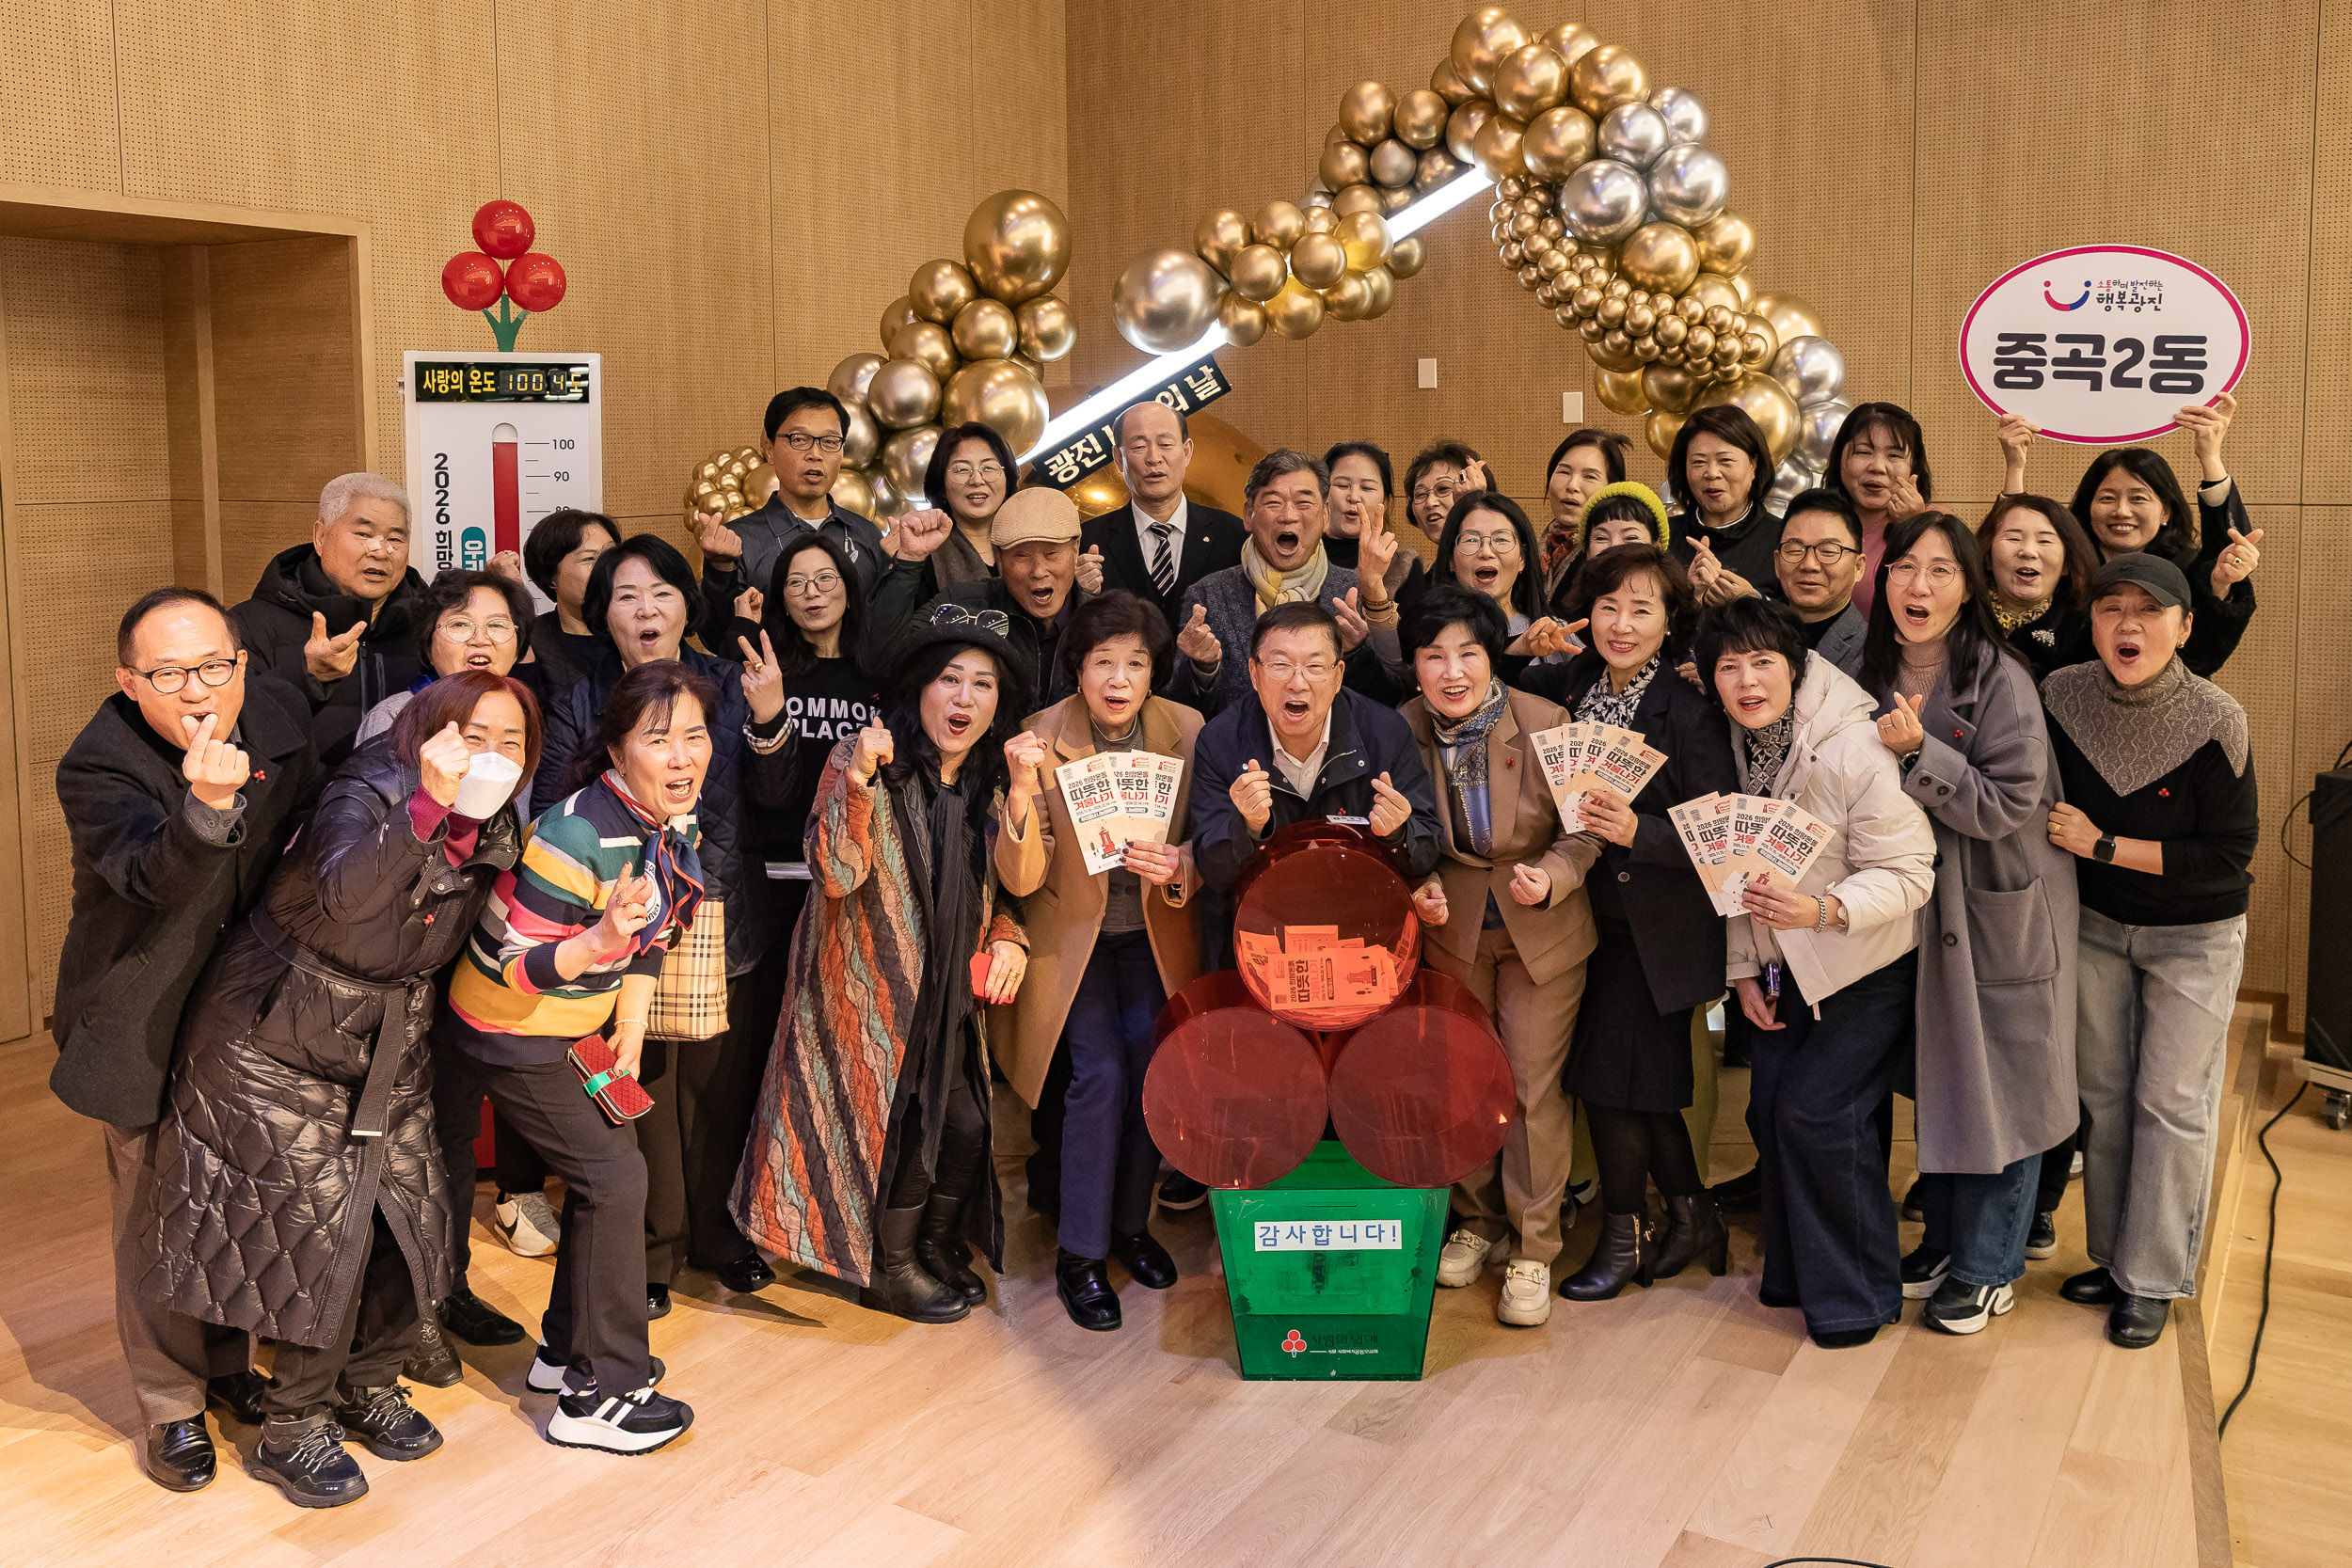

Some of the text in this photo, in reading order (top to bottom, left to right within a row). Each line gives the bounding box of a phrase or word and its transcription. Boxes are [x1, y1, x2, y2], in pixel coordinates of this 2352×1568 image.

[2097, 279, 2163, 293] 소통하며 발전하는
[2096, 291, 2163, 312] 행복광진
[1993, 333, 2208, 394] 중곡2동
[423, 370, 464, 393] 사랑의
[469, 370, 496, 393] 온도
[1044, 365, 1221, 483] 광진 날
[552, 439, 575, 450] 100
[554, 471, 570, 482] 90
[434, 452, 451, 525] 2026
[1613, 747, 1629, 757] 2026
[1600, 760, 1641, 784] 겨울나기
[1606, 751, 1647, 779] 따뜻한
[1067, 780, 1084, 789] 2026
[1069, 779, 1111, 801] 따뜻한
[1073, 791, 1114, 811] 겨울나기
[1696, 822, 1712, 831] 2026
[1737, 813, 1754, 821] 2026
[1777, 818, 1793, 832] 2026
[1763, 835, 1806, 865] 겨울나기
[1770, 824, 1814, 858] 따뜻한
[1295, 959, 1310, 1003] 따뜻한
[1259, 1224, 1396, 1246] 감사합니다!
